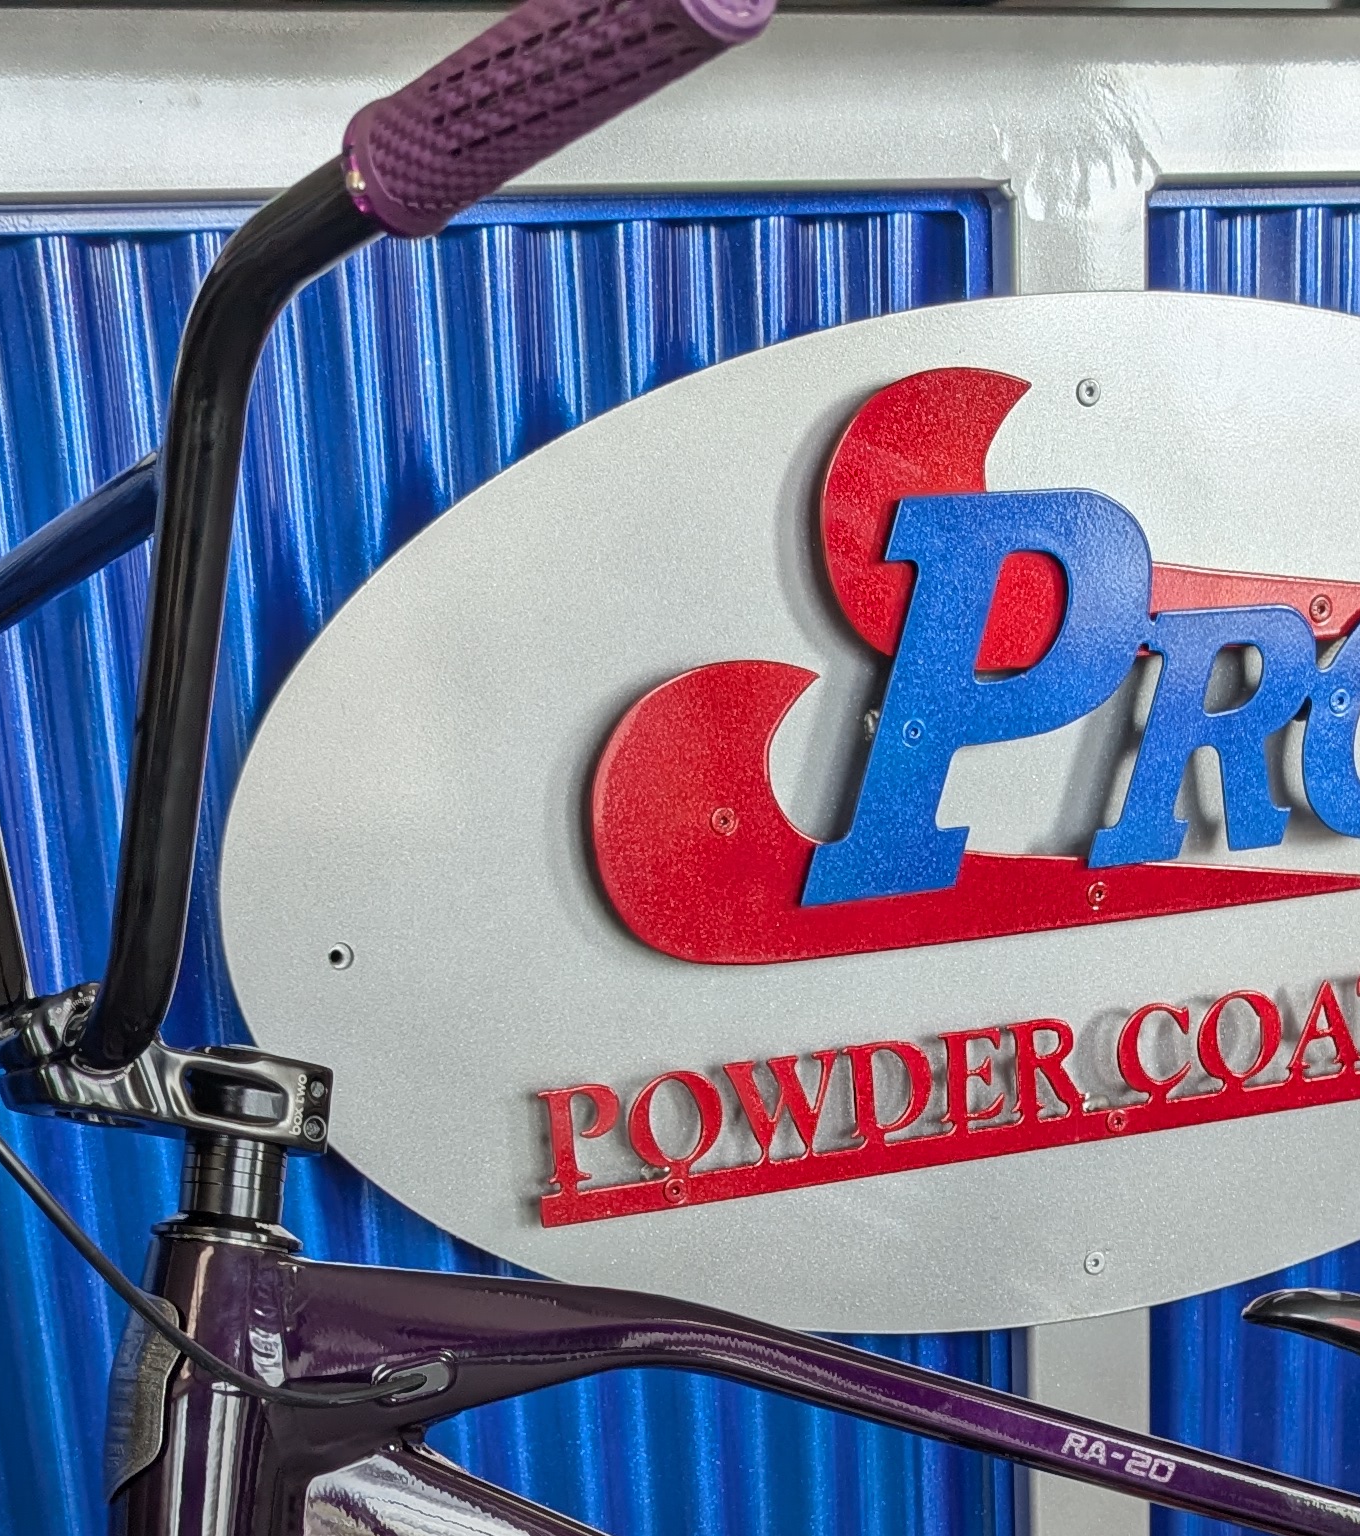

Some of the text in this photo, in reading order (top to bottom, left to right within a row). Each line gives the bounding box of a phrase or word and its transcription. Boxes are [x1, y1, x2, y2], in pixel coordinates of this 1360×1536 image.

[289, 1074, 308, 1136] box two
[536, 1017, 1086, 1194] POWDER
[1060, 1431, 1176, 1484] RA-20
